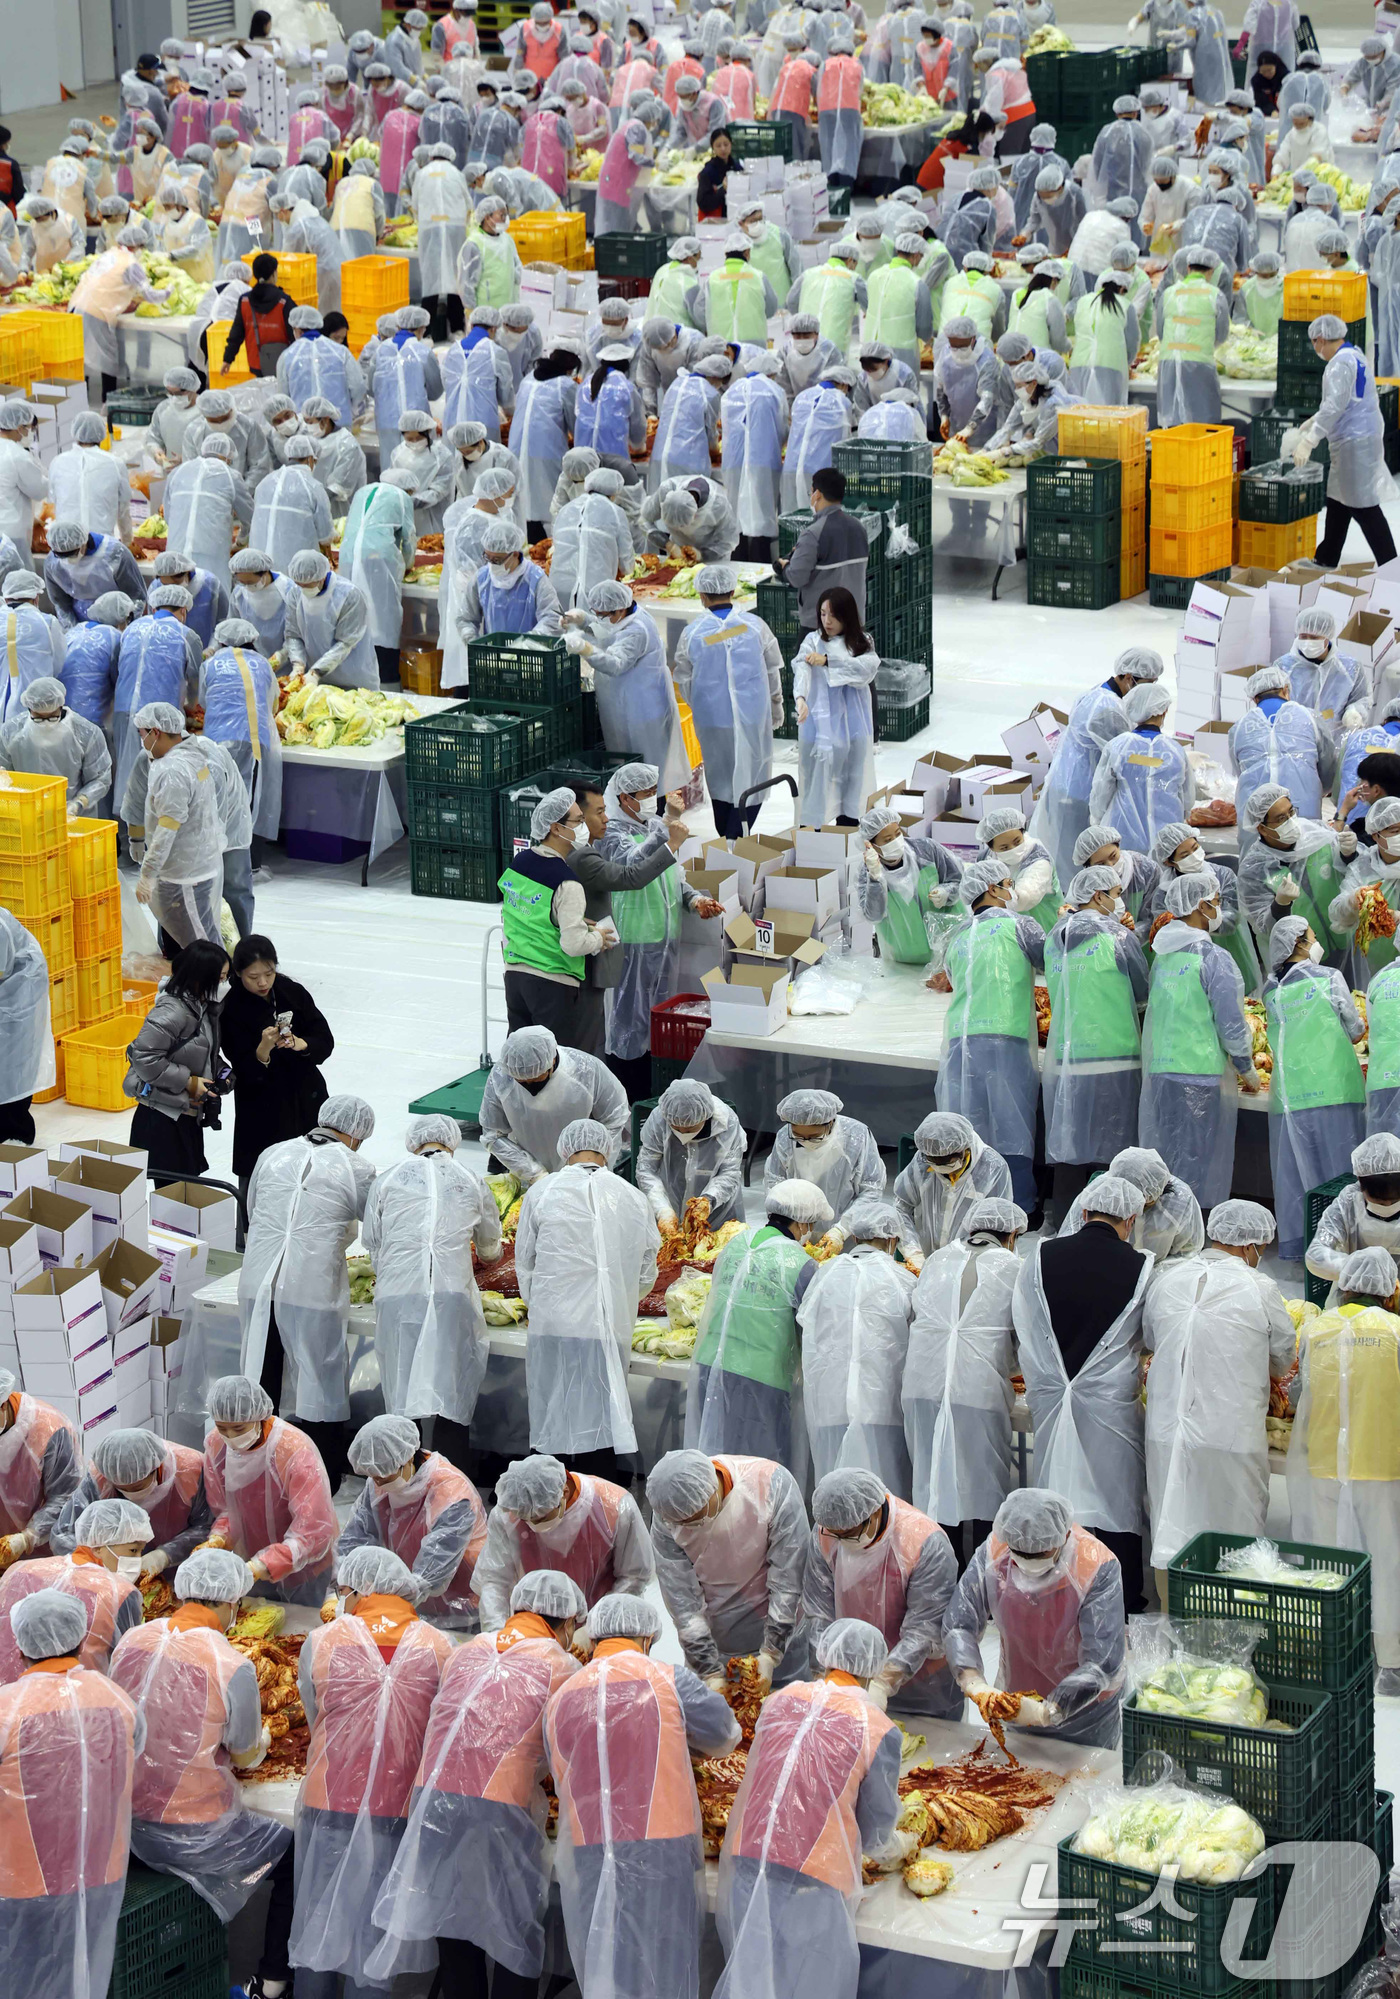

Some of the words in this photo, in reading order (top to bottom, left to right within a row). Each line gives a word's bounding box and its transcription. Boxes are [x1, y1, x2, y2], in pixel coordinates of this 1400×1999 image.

[214, 658, 259, 671] BEO
[758, 929, 770, 944] 10
[371, 1624, 387, 1634] SK
[497, 1634, 513, 1645] SK
